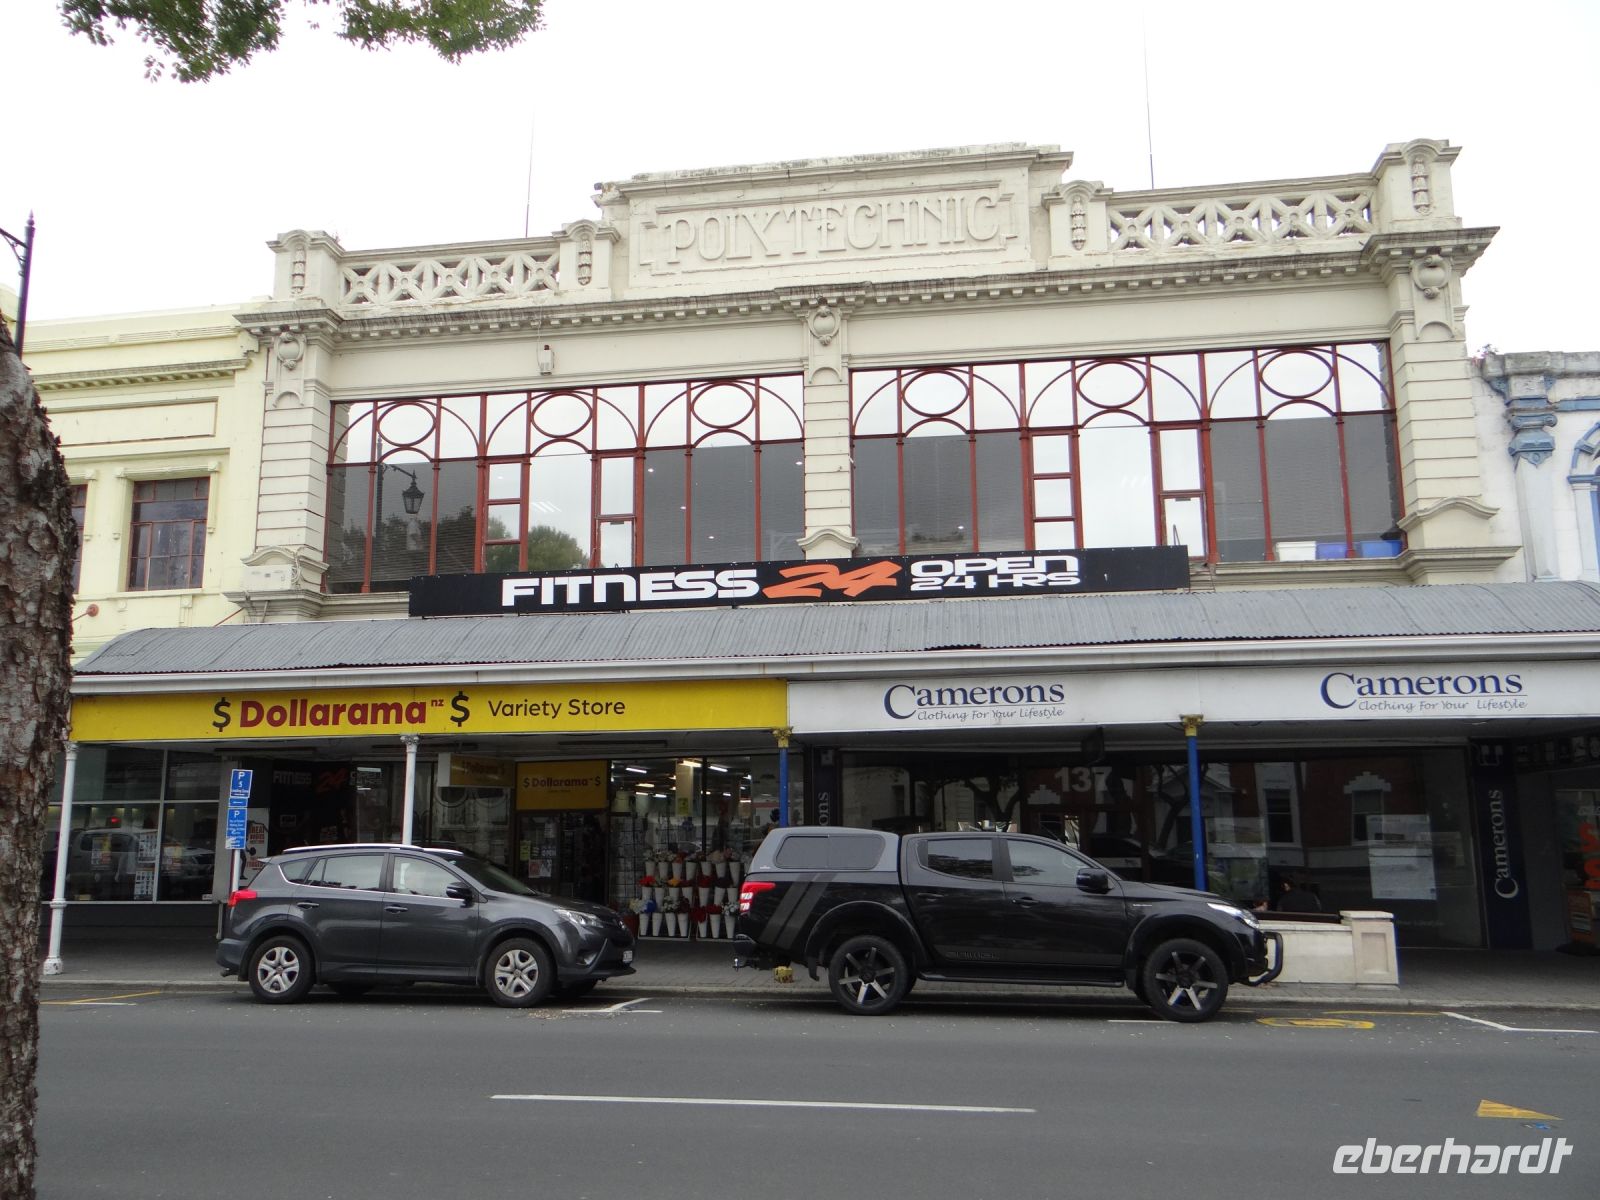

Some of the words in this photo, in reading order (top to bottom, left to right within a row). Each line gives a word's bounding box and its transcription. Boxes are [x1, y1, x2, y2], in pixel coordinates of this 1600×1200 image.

[666, 195, 1000, 264] POLYTECHNIC
[910, 555, 1079, 578] OPEN
[501, 569, 760, 607] FITNESS
[762, 560, 902, 598] 24
[910, 575, 976, 591] 24
[989, 572, 1082, 589] HRS
[883, 684, 1065, 720] Camerons
[1320, 672, 1523, 709] Camerons
[240, 699, 426, 728] Dollarama
[431, 699, 444, 707] nz
[488, 698, 562, 719] Variety
[568, 698, 625, 715] Store
[917, 710, 968, 722] Clothing
[971, 710, 989, 720] For
[992, 708, 1016, 719] Your
[1019, 706, 1065, 719] Lifestyle
[1358, 700, 1416, 713] Clothing
[1419, 700, 1437, 711] For
[1441, 700, 1469, 711] Your
[1476, 698, 1529, 711] Lifestyle
[1488, 789, 1519, 899] Camerons
